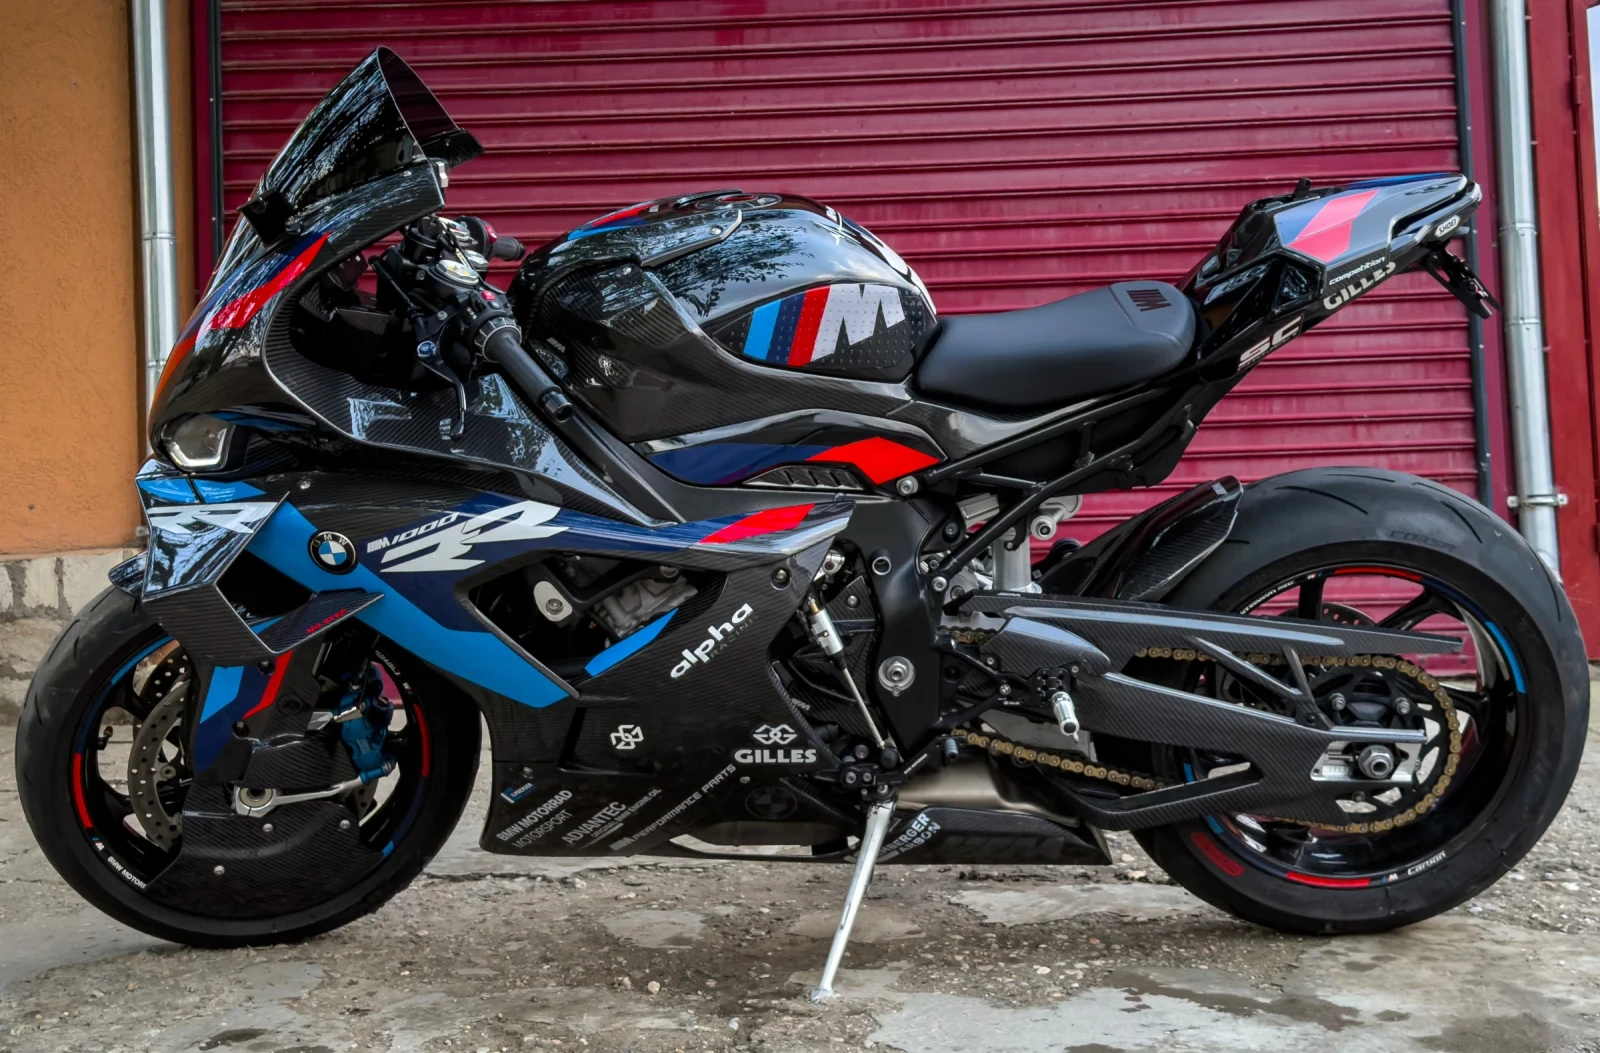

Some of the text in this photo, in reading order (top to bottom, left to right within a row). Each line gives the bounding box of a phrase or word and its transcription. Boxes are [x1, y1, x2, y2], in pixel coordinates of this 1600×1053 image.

[1438, 217, 1459, 235] SHOEI
[1328, 256, 1386, 285] competition
[1239, 315, 1302, 361] SC
[670, 602, 754, 679] alpha
[733, 749, 817, 763] GILLES
[496, 790, 573, 841] BMW MOTORRAD
[628, 797, 651, 813] ENGINE
[648, 788, 662, 799] OIL
[632, 791, 702, 840] PERFORMANCE
[701, 763, 736, 793] PARTS
[512, 809, 573, 848] MOTORSPORT
[562, 801, 626, 844] ADVANTEC
[107, 855, 123, 871] BMW
[1407, 850, 1447, 876] Carbon
